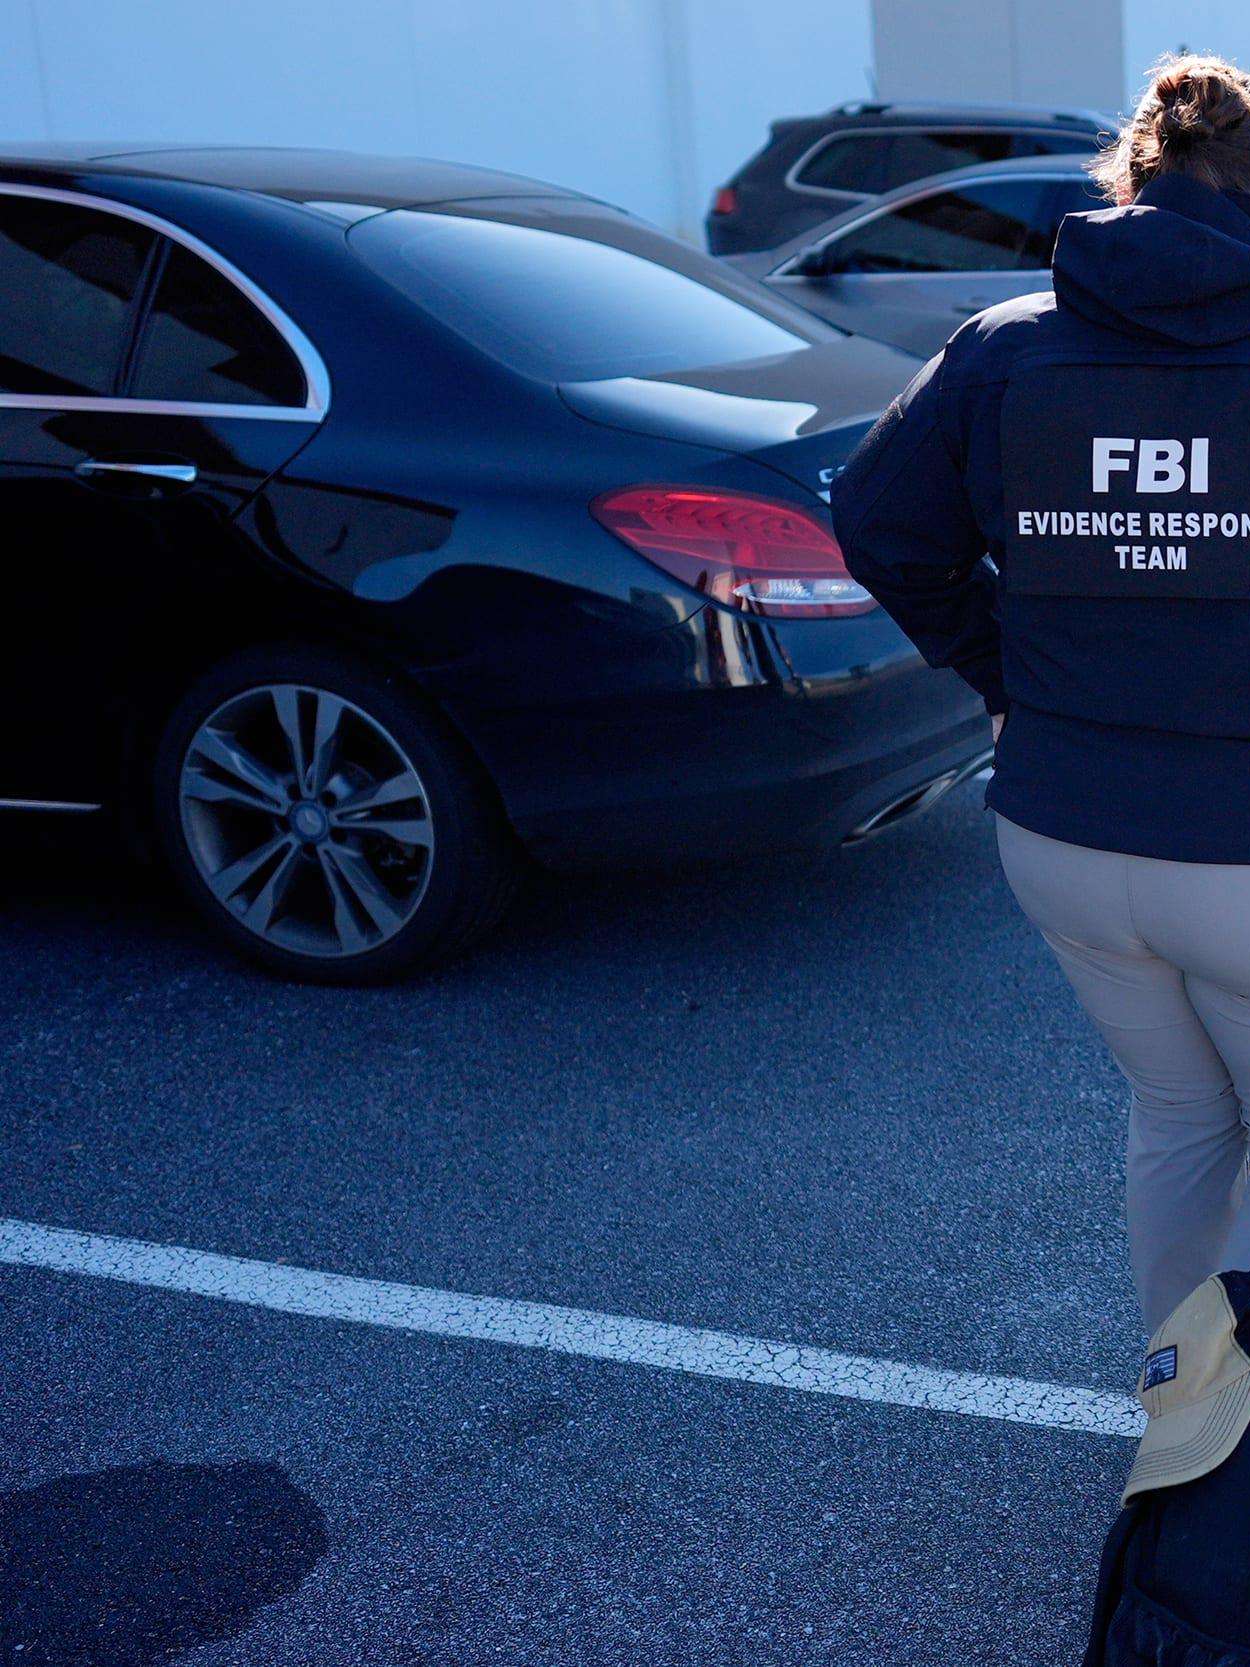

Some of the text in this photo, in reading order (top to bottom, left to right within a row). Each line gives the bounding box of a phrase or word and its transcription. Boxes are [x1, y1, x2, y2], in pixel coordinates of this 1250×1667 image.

[1092, 437, 1209, 493] FBI
[1018, 511, 1142, 537] EVIDENCE
[1114, 545, 1187, 570] TEAM
